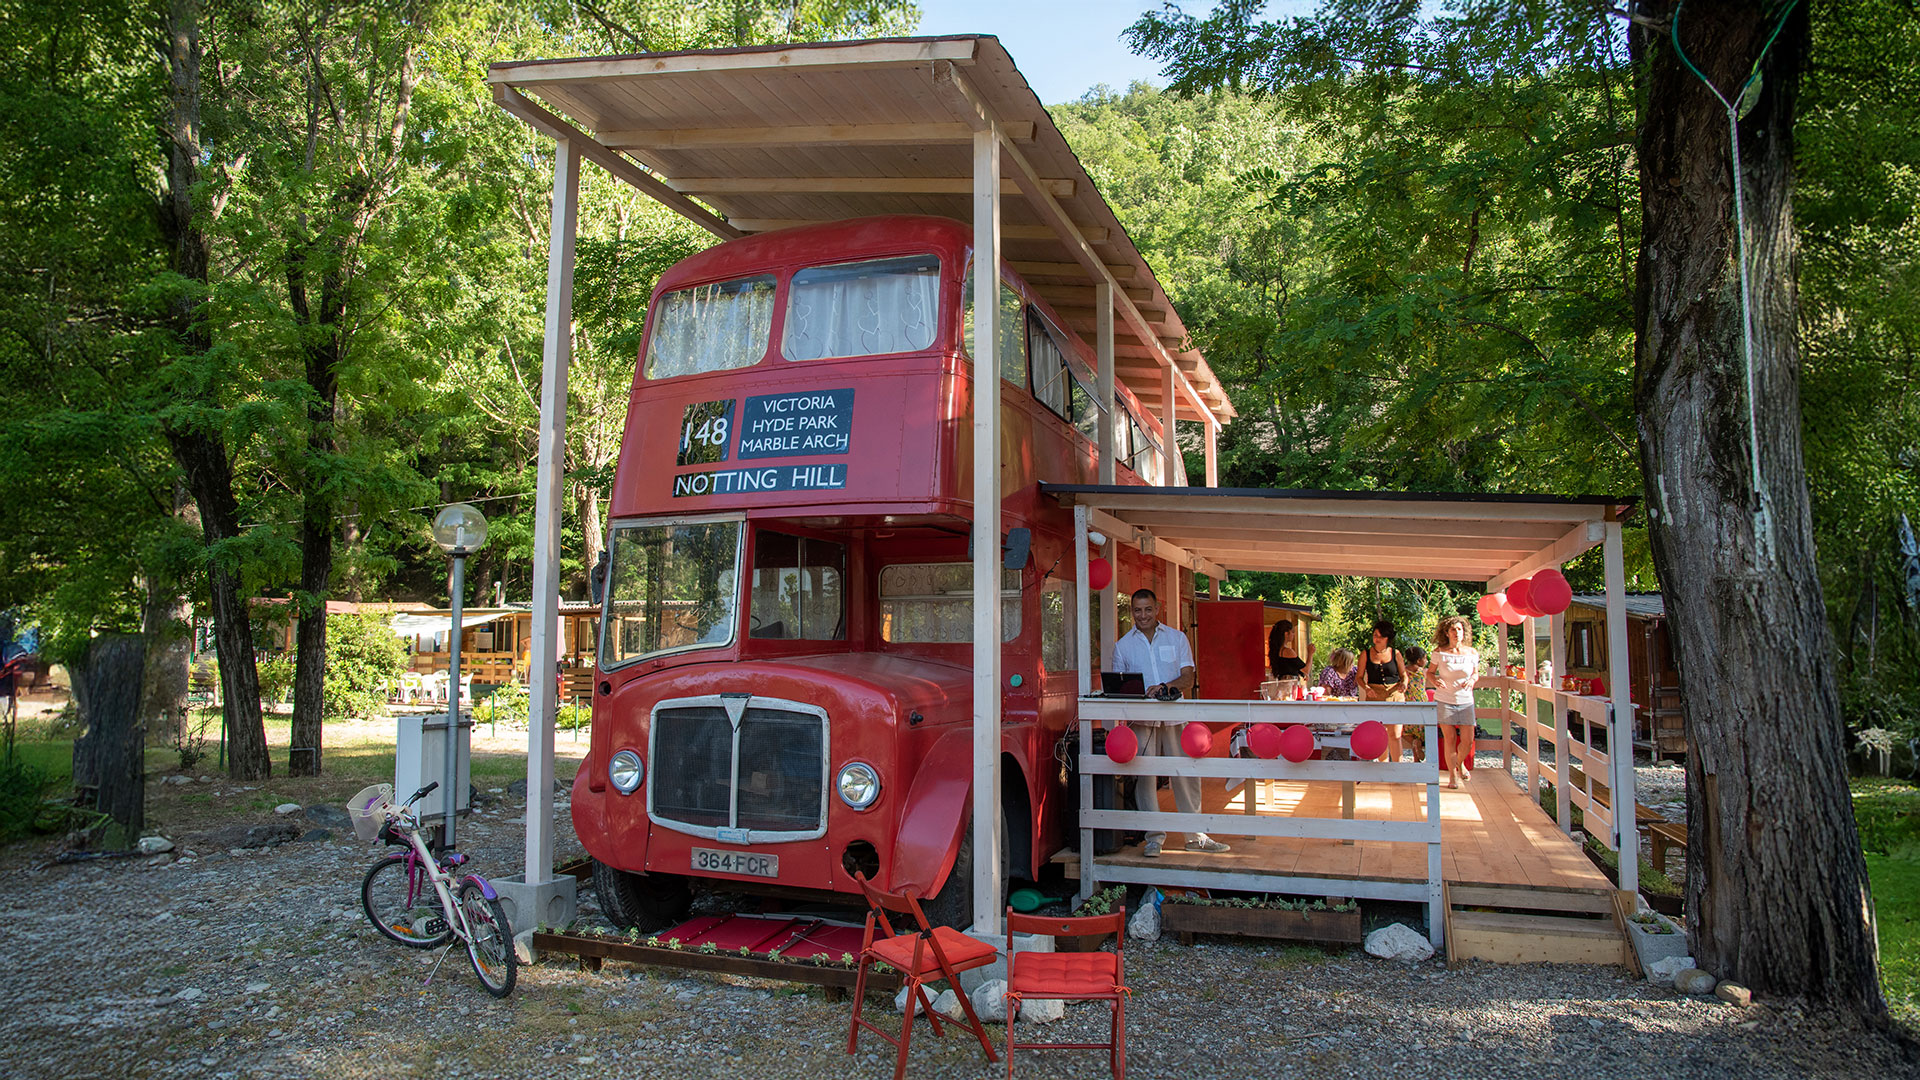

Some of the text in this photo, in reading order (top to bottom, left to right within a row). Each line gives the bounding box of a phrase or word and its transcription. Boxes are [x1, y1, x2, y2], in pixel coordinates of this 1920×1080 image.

[763, 395, 835, 413] VICTORIA
[683, 418, 728, 449] 148
[752, 415, 838, 433] HYDE PARK
[740, 433, 848, 453] MARBLE ARCH
[675, 466, 843, 495] NOTTING HILL
